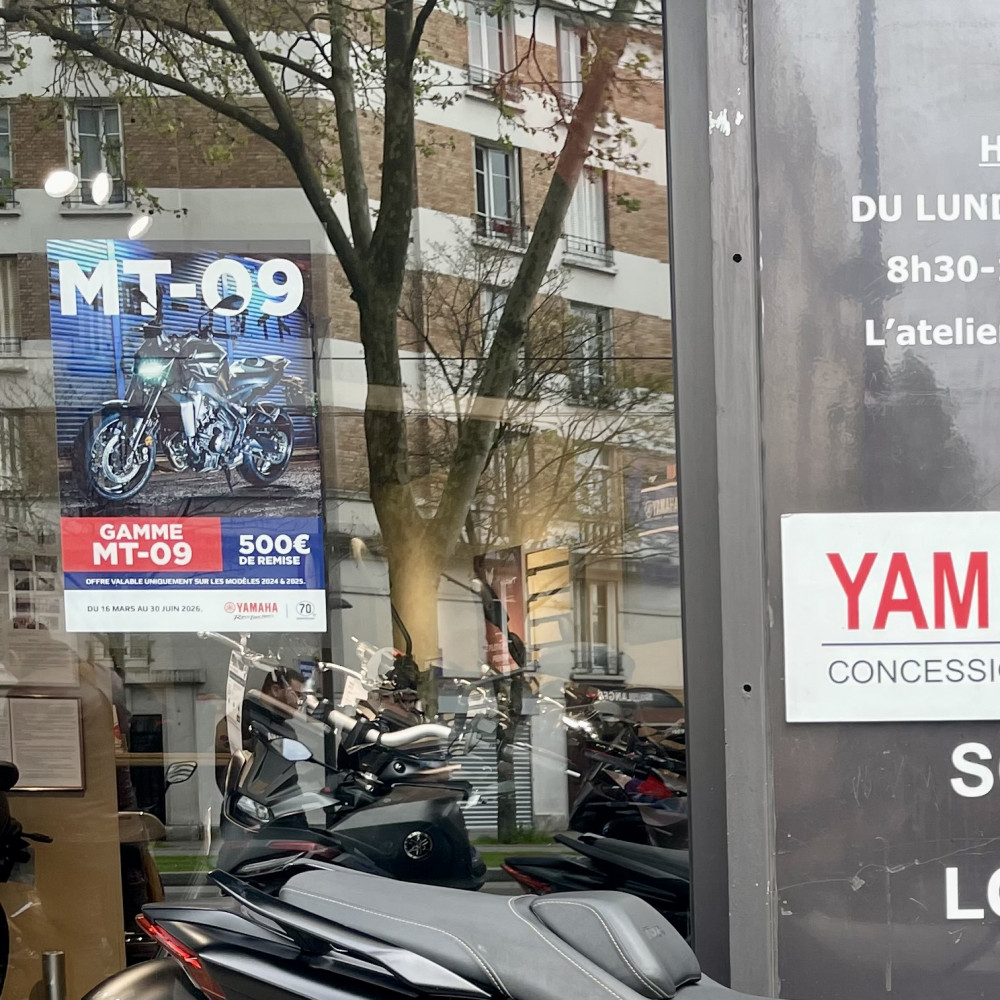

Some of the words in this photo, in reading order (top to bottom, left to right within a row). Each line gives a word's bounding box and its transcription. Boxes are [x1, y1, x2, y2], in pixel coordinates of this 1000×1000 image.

[852, 195, 902, 223] DU
[58, 258, 304, 317] MT-09
[100, 524, 183, 540] GAMME
[239, 534, 310, 555] 500€
[92, 542, 192, 566] MT-09
[238, 556, 255, 566] DE
[257, 556, 301, 566] REMISE
[86, 578, 110, 586] OFFRE
[111, 578, 144, 586] VALABLE
[144, 578, 193, 586] UNIQUEMENT
[194, 577, 210, 585] SUR
[210, 577, 225, 585] LES
[826, 551, 990, 630] YAM
[236, 602, 278, 613] YAMAHA
[299, 603, 312, 614] 70
